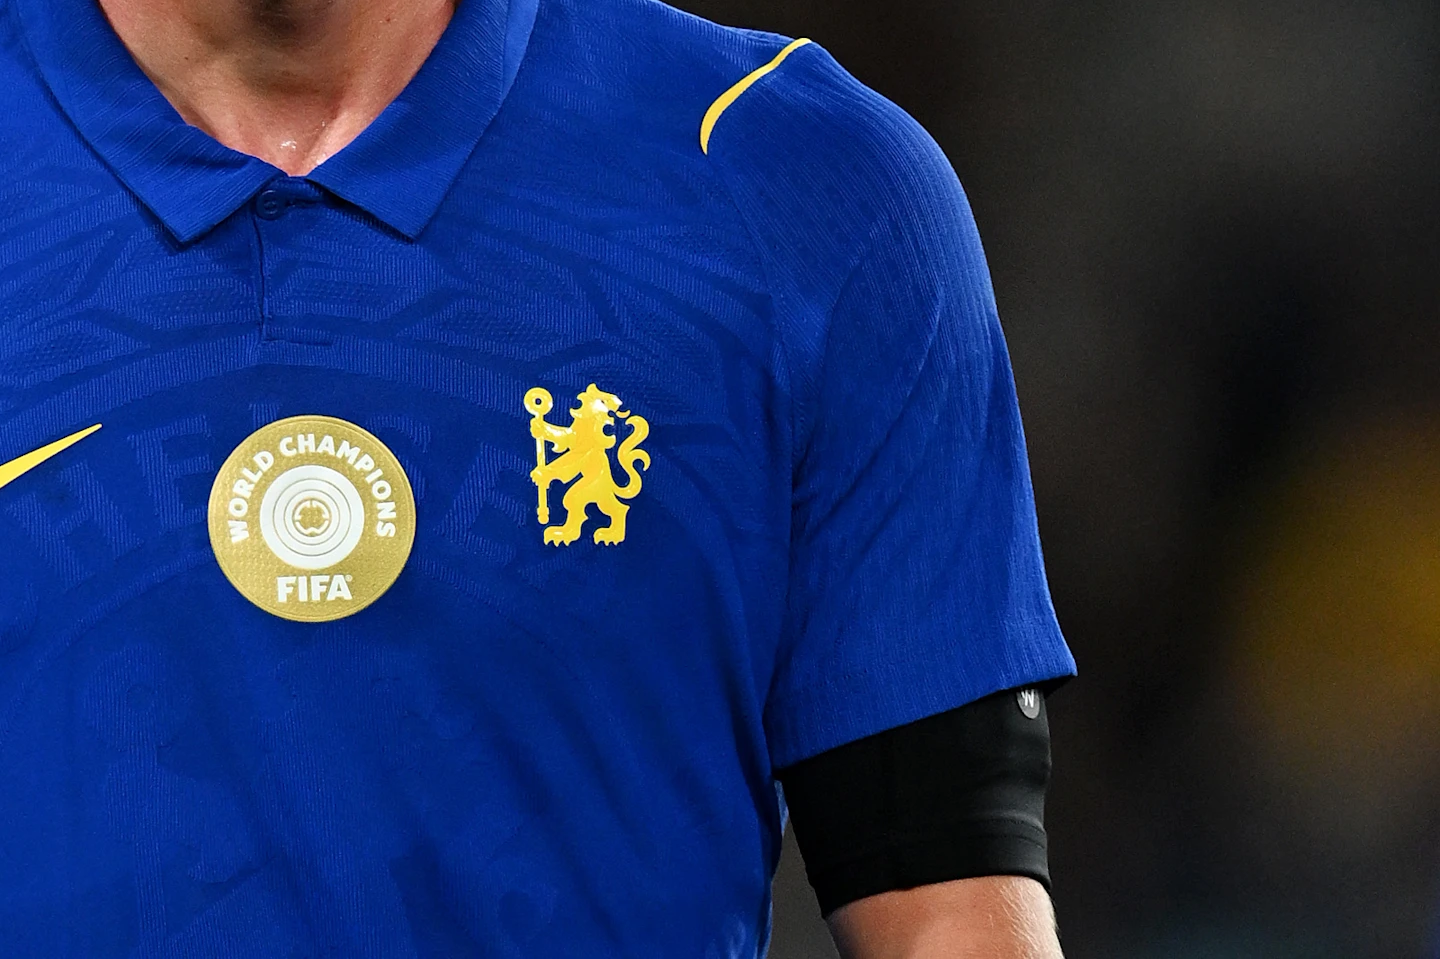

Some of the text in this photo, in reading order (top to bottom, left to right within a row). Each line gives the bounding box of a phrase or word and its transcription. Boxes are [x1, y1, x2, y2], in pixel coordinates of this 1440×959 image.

[226, 433, 397, 544] WORLD CHAMPIONS
[276, 575, 353, 603] FIFA
